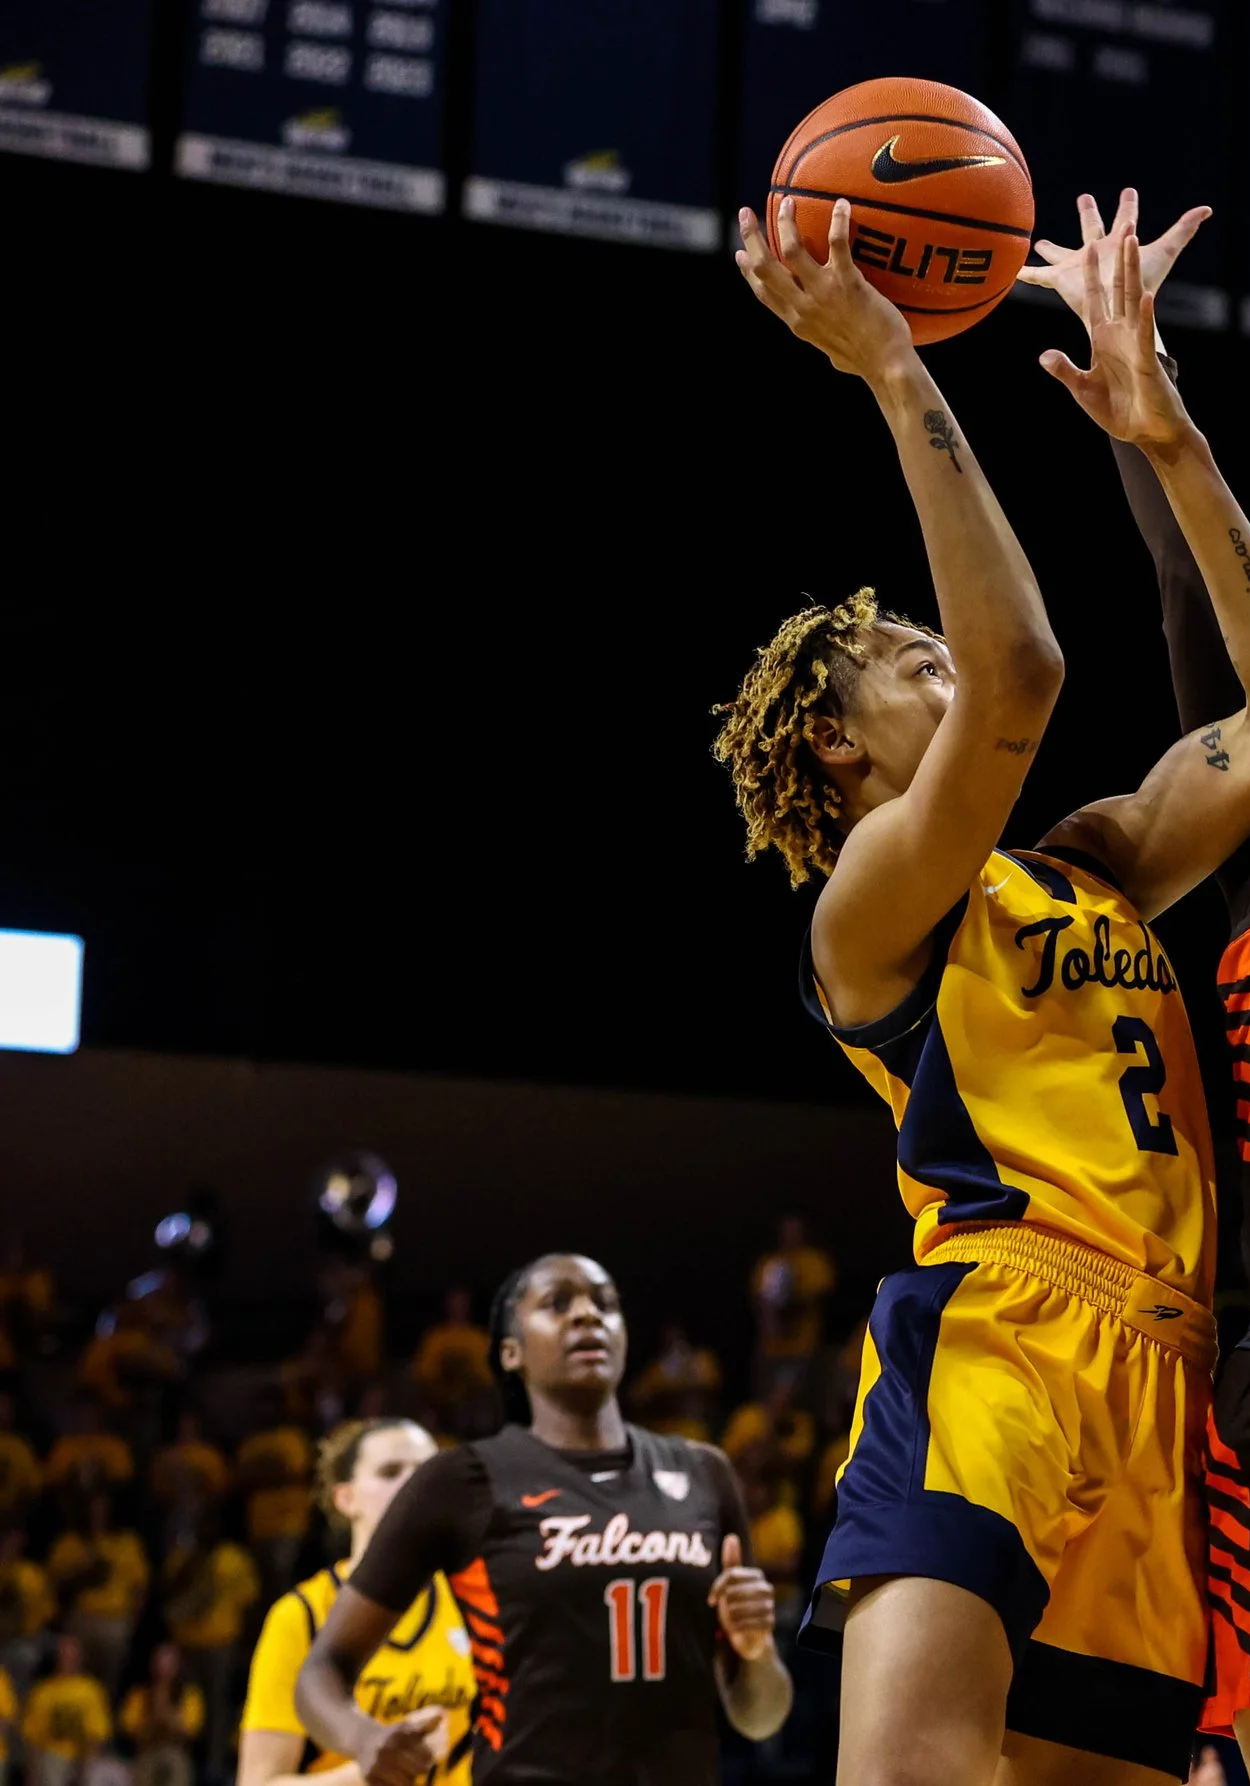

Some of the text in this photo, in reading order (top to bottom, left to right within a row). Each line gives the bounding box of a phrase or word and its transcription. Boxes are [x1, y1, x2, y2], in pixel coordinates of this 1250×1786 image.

[852, 225, 993, 284] ELITE
[1201, 728, 1230, 771] 44
[1014, 914, 1177, 998] Toledo
[1112, 1015, 1179, 1156] 2
[535, 1513, 712, 1571] Falcons
[604, 1577, 669, 1682] 11
